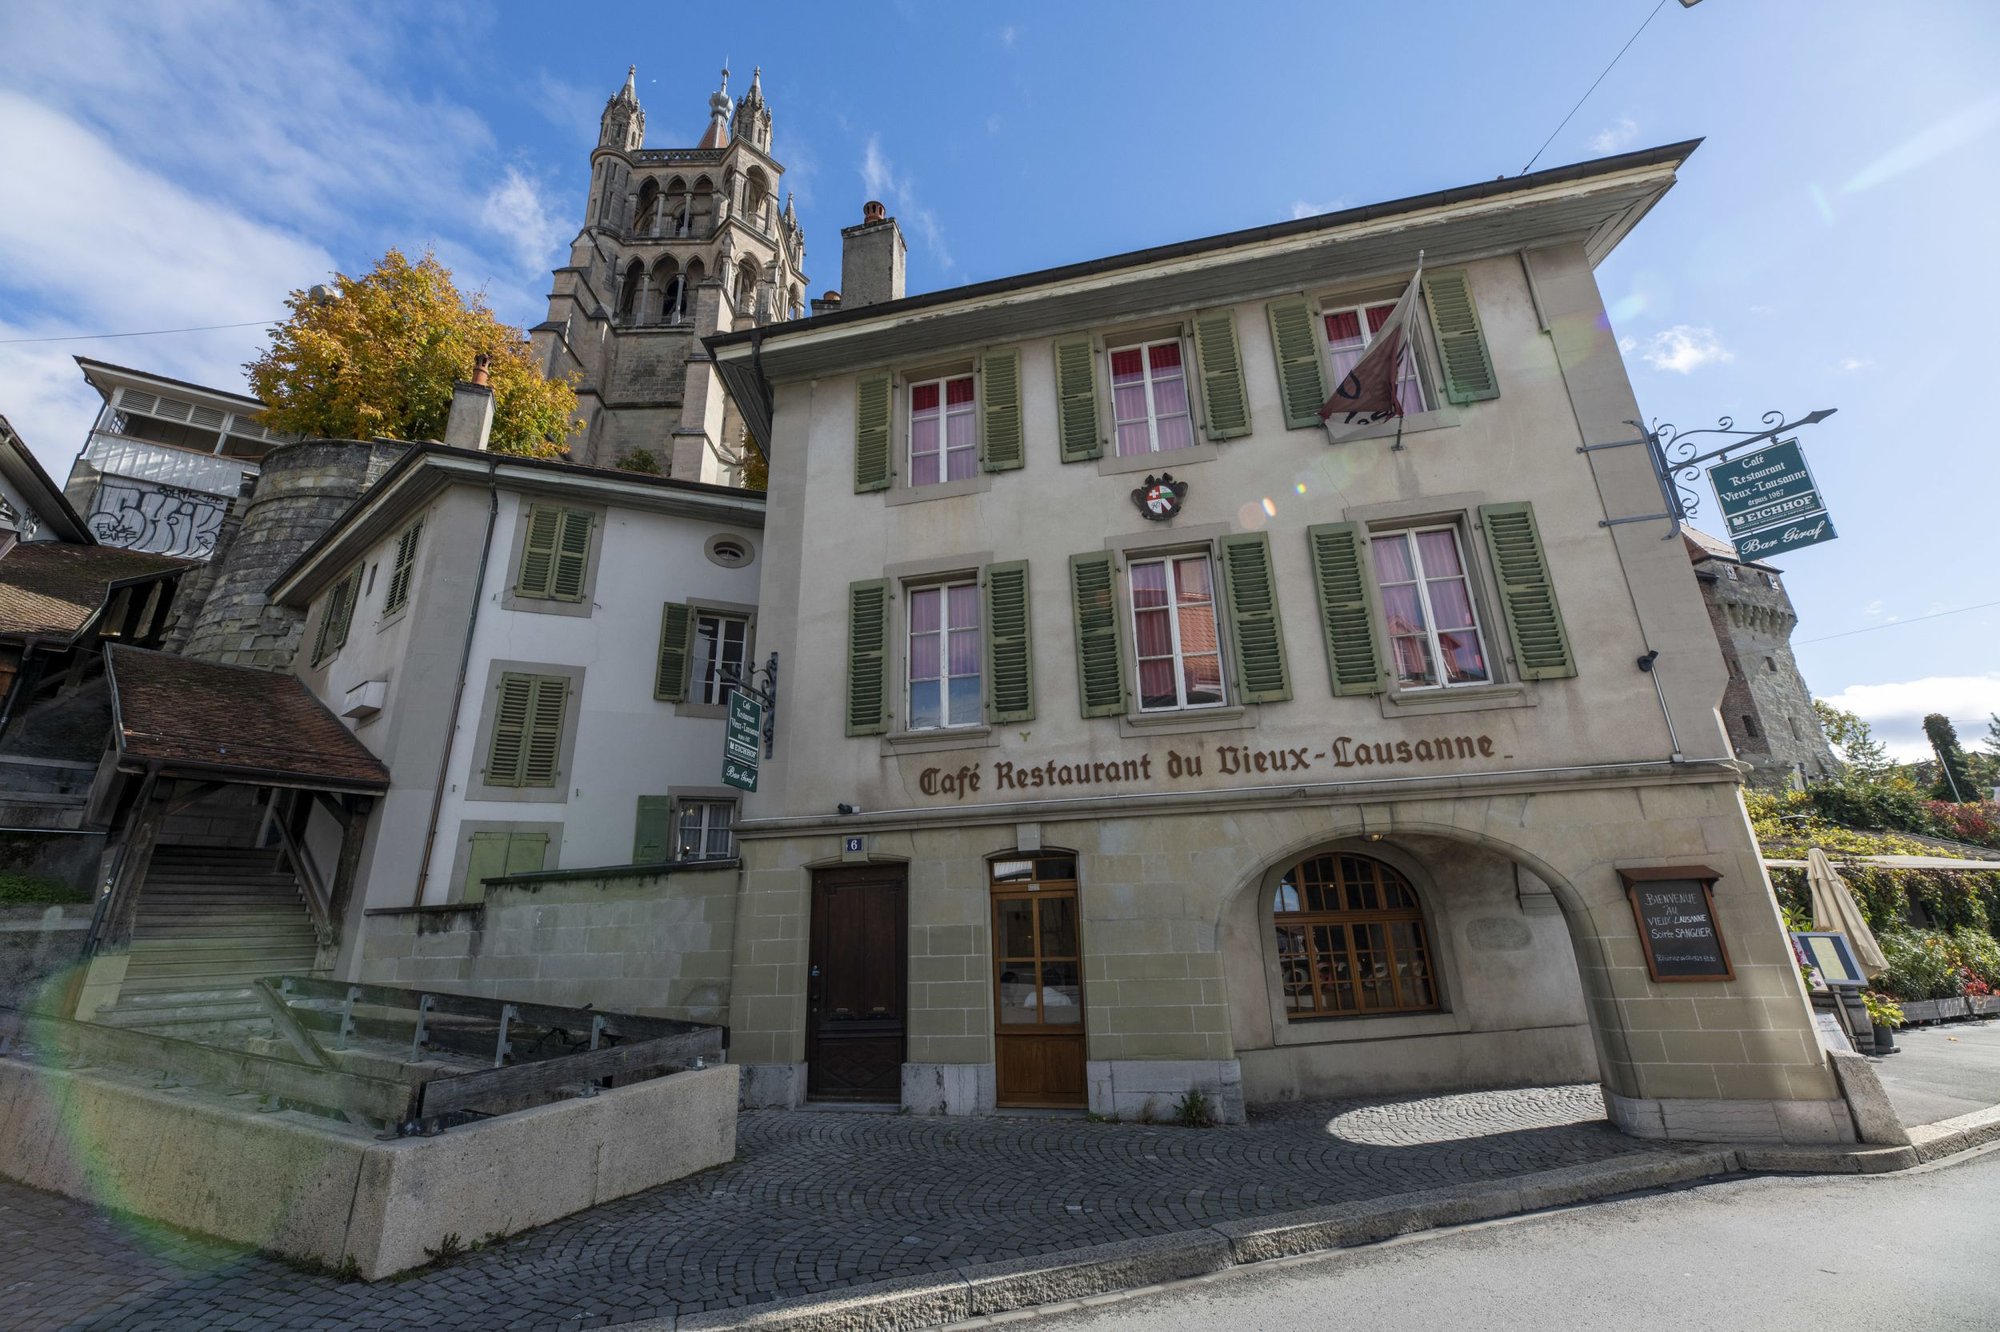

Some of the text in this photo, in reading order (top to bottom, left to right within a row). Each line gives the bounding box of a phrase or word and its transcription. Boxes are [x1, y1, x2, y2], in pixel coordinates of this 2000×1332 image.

[1741, 454, 1765, 469] Café
[1729, 462, 1786, 486] Restaurant
[1720, 470, 1808, 502] Vieux-Lausanne
[1747, 495, 1768, 506] depuis
[1746, 496, 1813, 522] EICHHOF
[94, 522, 133, 532] FUCK
[99, 531, 138, 542] BUFF
[1741, 520, 1826, 555] Bar Giraf
[726, 765, 740, 780] Bar
[919, 762, 981, 800] Café
[994, 752, 1152, 791] Restaurant
[1167, 749, 1203, 779] du
[850, 839, 858, 851] 6
[1644, 892, 1698, 906] BIENVENUE
[1665, 905, 1679, 916] AU
[1651, 926, 1712, 939] Soirée SANGLIER
